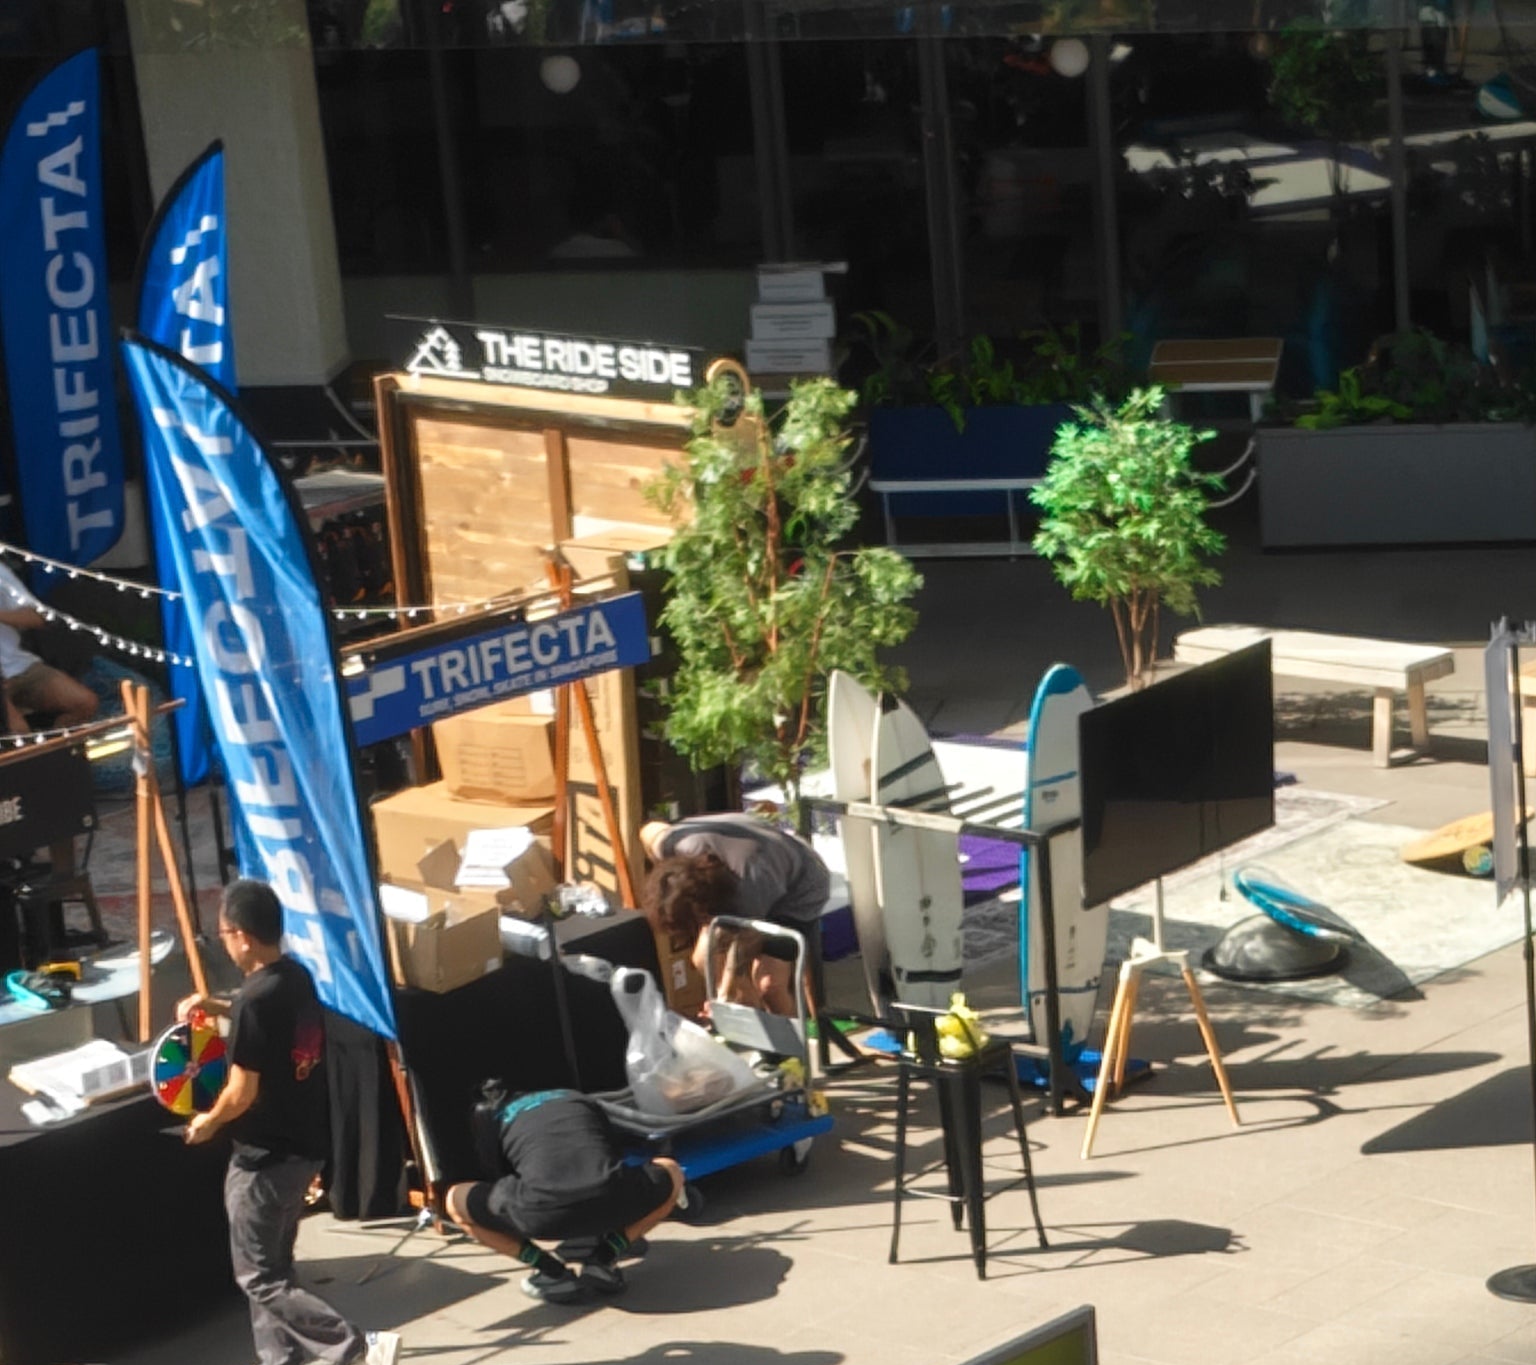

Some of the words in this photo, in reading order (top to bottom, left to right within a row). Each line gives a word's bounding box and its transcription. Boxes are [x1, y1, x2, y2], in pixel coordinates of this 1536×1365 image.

[38, 136, 115, 551] TRIFECTA
[475, 329, 542, 370] THE
[543, 340, 617, 379] RIDE
[618, 350, 693, 387] SIDE
[410, 609, 617, 700] TRIFECTA
